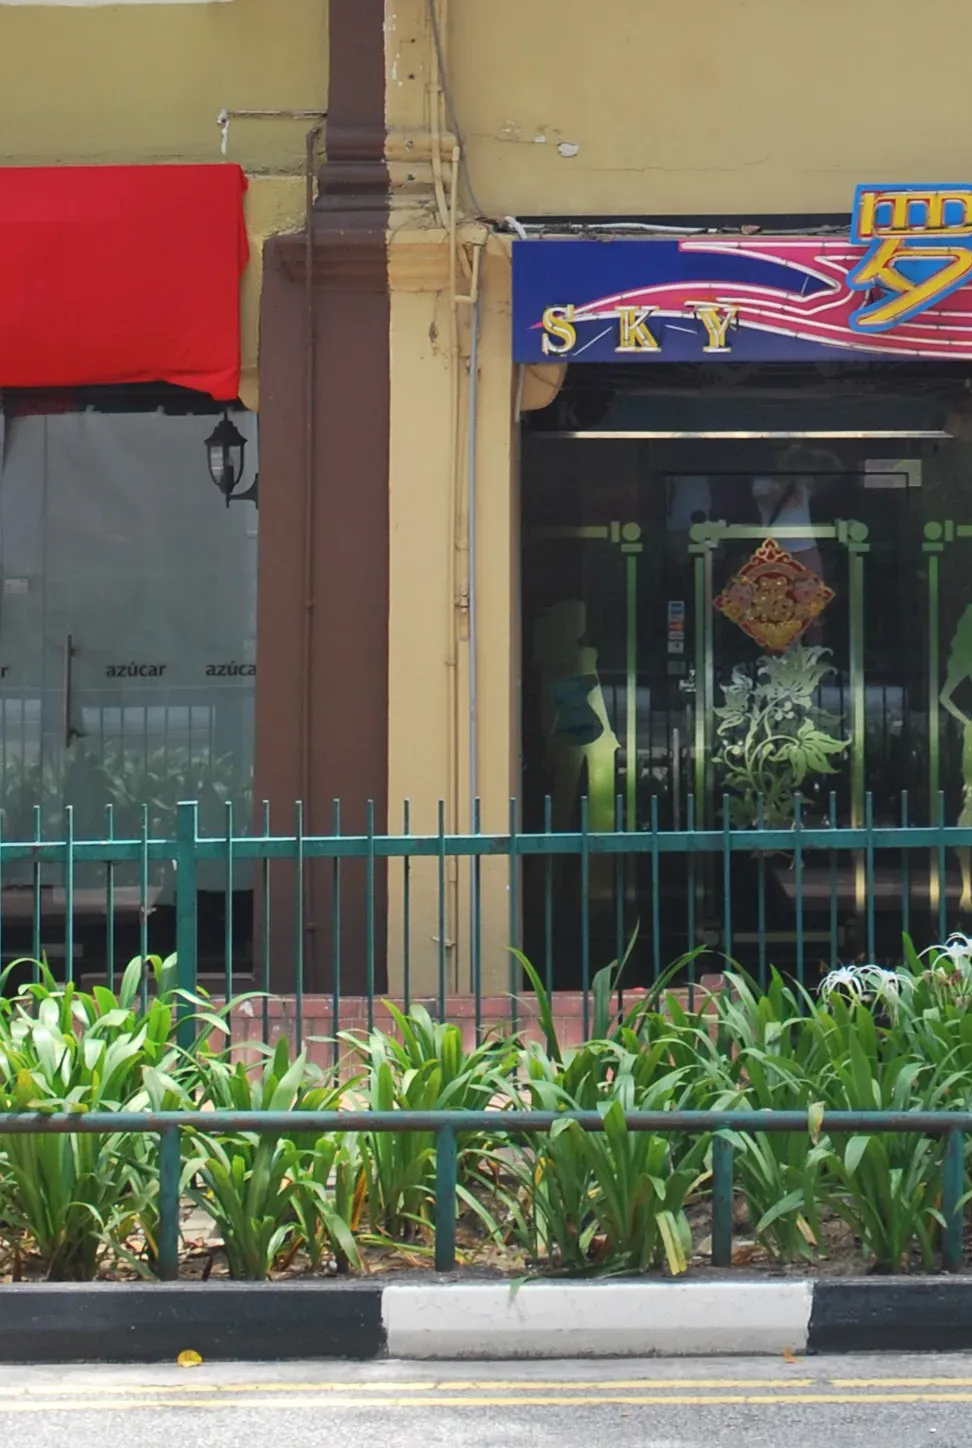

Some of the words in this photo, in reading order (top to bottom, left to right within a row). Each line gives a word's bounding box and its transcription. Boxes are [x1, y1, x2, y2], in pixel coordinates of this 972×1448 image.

[541, 303, 739, 356] SKY
[105, 661, 167, 678] azúcar
[205, 659, 257, 677] azúca
